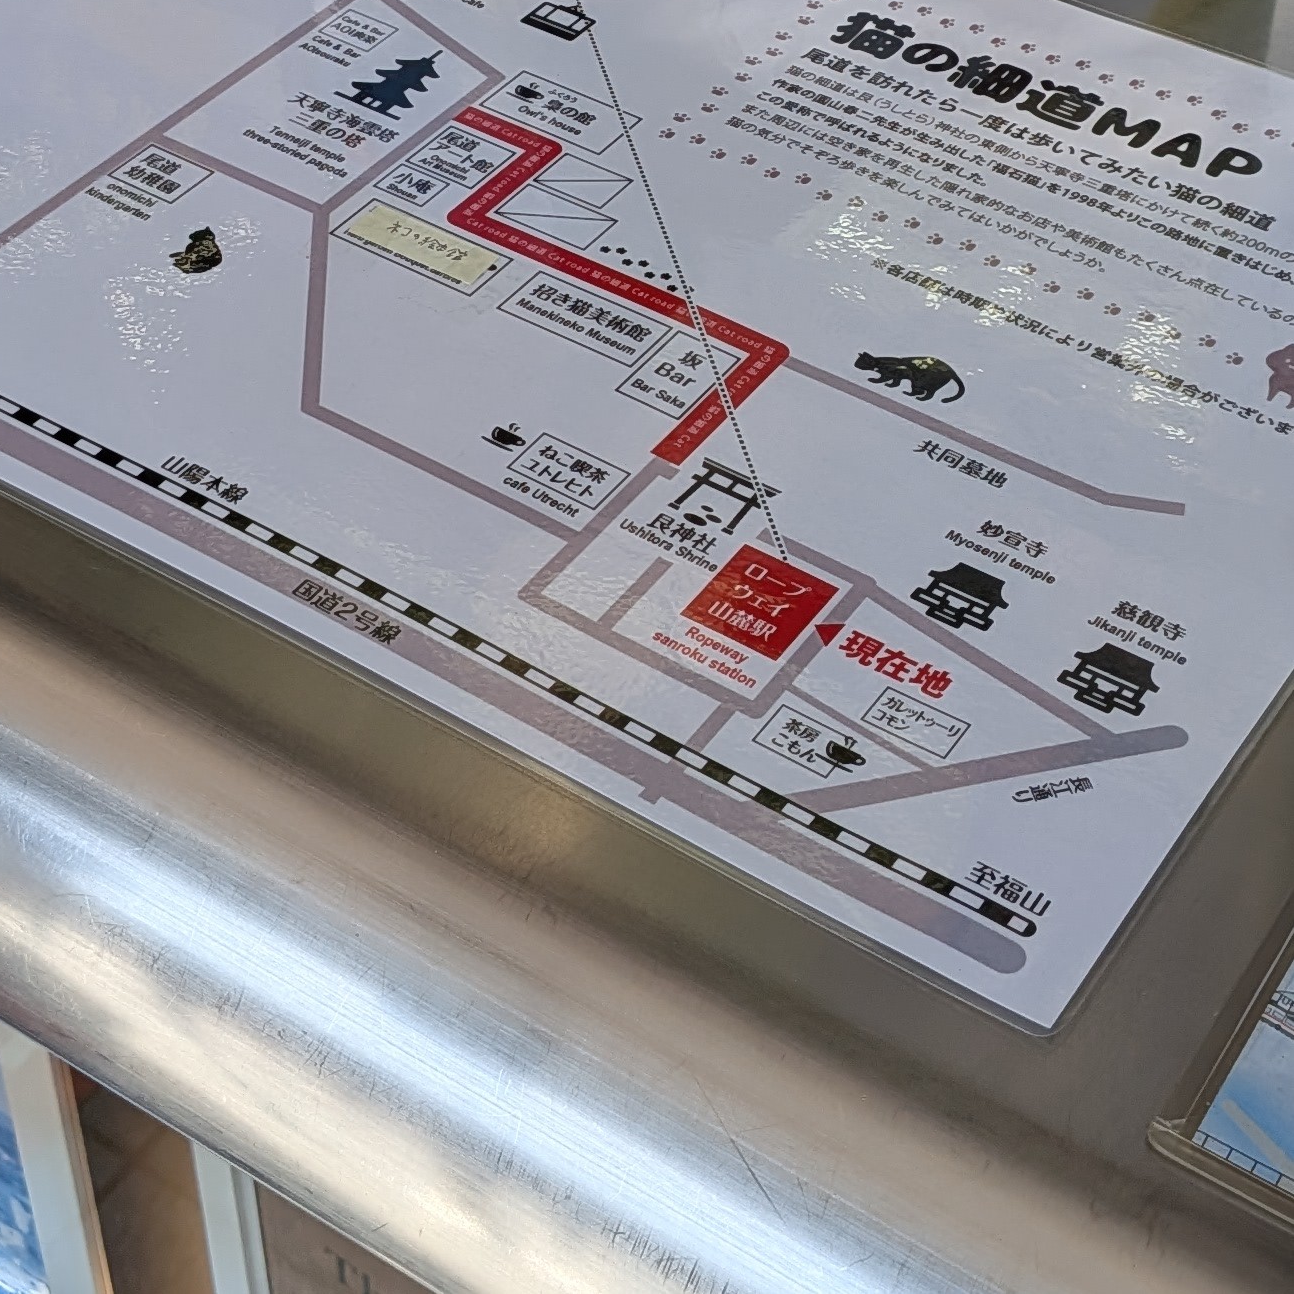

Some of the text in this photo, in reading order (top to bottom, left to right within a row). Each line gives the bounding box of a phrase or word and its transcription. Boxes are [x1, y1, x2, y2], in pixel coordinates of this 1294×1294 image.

[312, 35, 332, 48] Cafe
[343, 47, 362, 59] Bar
[829, 11, 1264, 178] 猫の細道MAP
[287, 92, 400, 144] 天寧寺海雲塔
[288, 112, 367, 149] 三重の塔
[518, 105, 582, 136] Owl's house
[243, 128, 349, 180] three-storied pagoda
[310, 143, 346, 164] temple
[428, 142, 496, 174] アート館
[439, 131, 480, 152] 尾道
[800, 47, 1277, 232] 尾道を訪れたら一度は歩いてみたい猫の細道
[123, 165, 182, 196] 幼稚園
[140, 153, 182, 176] 尾道
[392, 173, 437, 195] 小庵
[85, 186, 151, 222] kindergarten
[107, 182, 158, 208] onomichi
[530, 282, 652, 344] 招き猫美術館
[547, 250, 565, 264] Cat
[566, 260, 591, 274] road
[631, 287, 649, 299] Cat
[650, 296, 674, 310] road
[718, 324, 735, 338] Cat
[734, 335, 762, 350] road
[515, 298, 637, 357] Manekineko Museum
[654, 361, 697, 387] Bar
[678, 350, 707, 371] 坂
[630, 377, 686, 409] Bar Saka
[160, 455, 249, 504] 山陽本線
[520, 458, 595, 497] ユトレヒト
[538, 443, 611, 484] ねこ喫茶
[912, 438, 1008, 489] 共同墓地
[503, 474, 580, 518] cafe Utrecht
[619, 518, 719, 573] Ushitora Shrine
[646, 510, 720, 556] 艮神社
[976, 519, 1049, 559] 妙宣寺
[944, 528, 1057, 586] Myosenji temple
[743, 562, 812, 597] ロープ
[292, 578, 402, 645] 国道2号線
[731, 583, 792, 617] ウェイ
[707, 601, 778, 643] 山麓駅
[1111, 600, 1188, 642] 慈観寺
[651, 630, 758, 689] sanroku station
[684, 626, 749, 664] Ropeway
[1087, 615, 1188, 667] Jikanji temple
[838, 629, 954, 700] 現在地
[783, 717, 819, 744] 茶房
[871, 709, 911, 732] コモン
[770, 735, 817, 763] こもん
[1012, 777, 1094, 803] 長江通り
[964, 860, 1052, 917] 至福山
